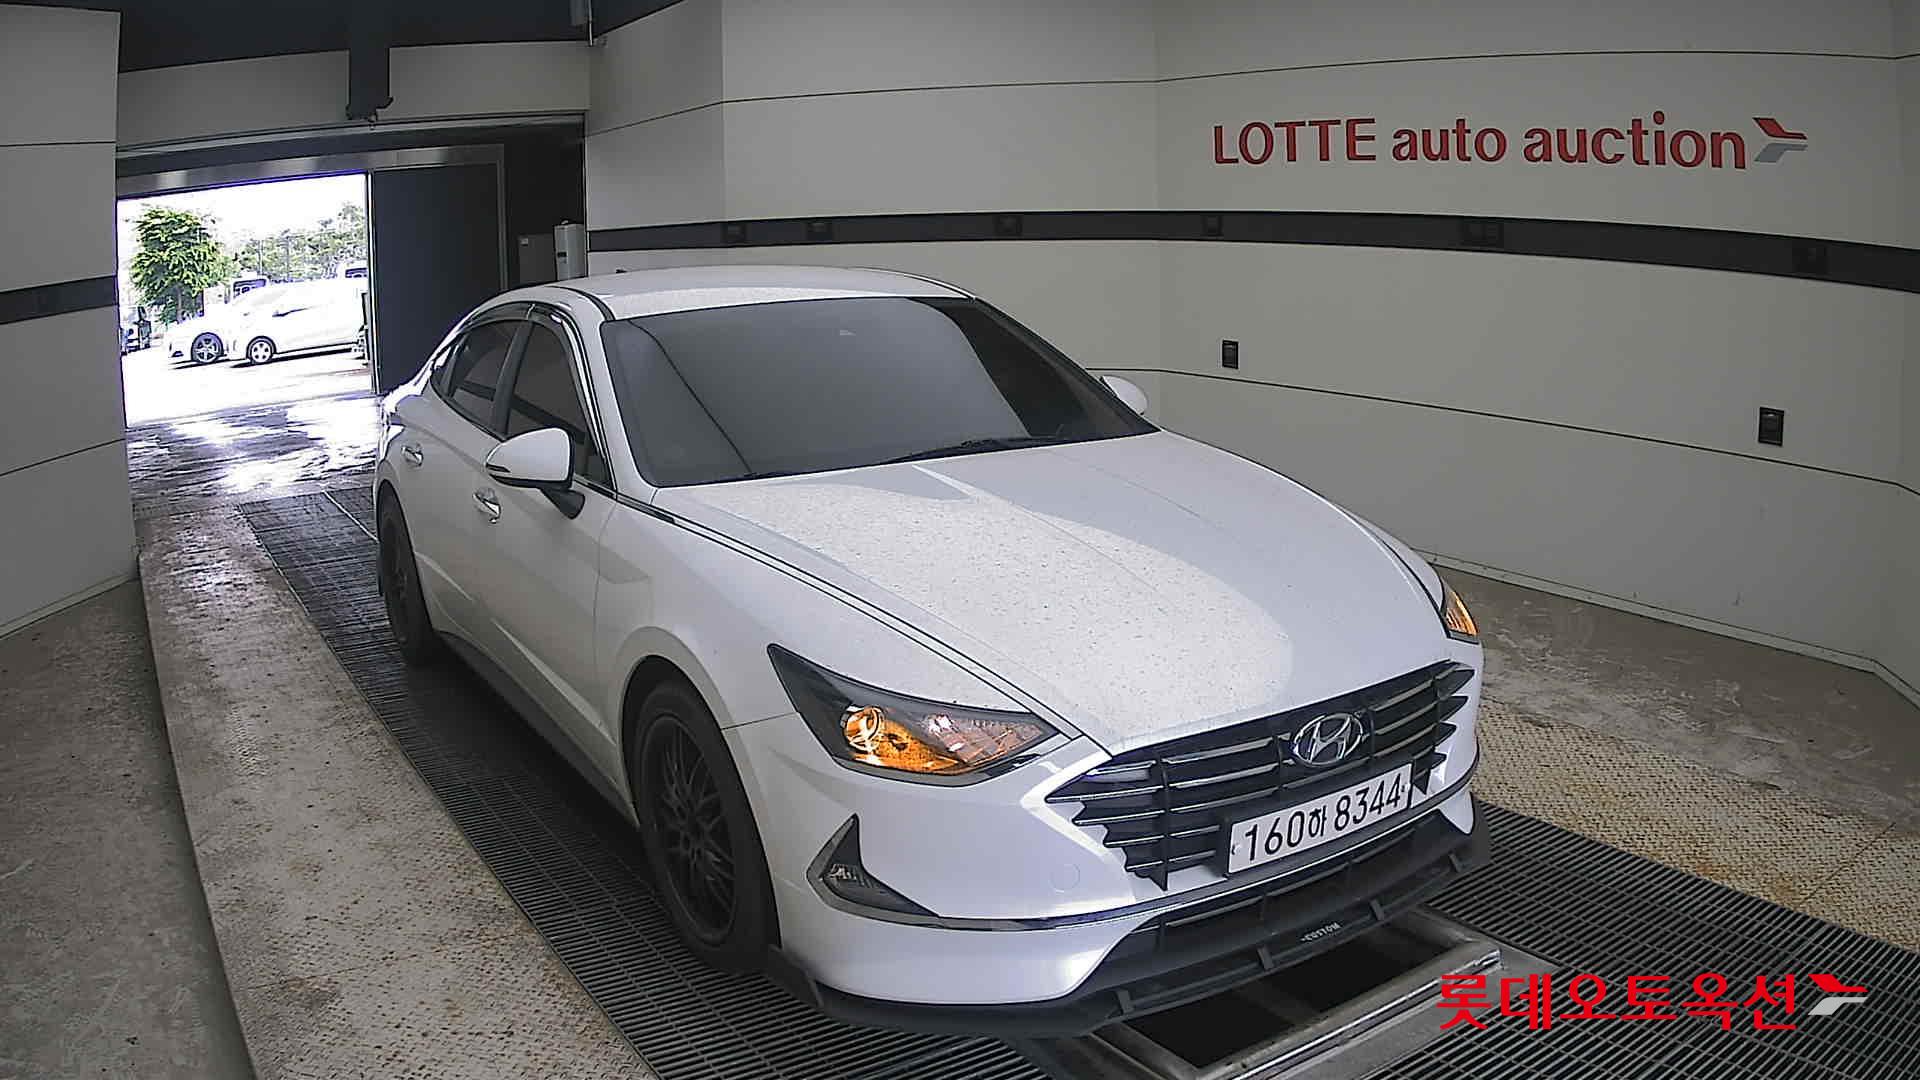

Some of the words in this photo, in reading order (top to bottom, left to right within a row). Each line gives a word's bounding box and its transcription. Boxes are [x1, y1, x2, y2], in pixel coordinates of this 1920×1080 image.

[1214, 118, 1376, 164] LOTTE
[1392, 118, 1507, 162] auto
[1523, 110, 1746, 169] auction
[1245, 805, 1327, 861] 160하
[1334, 773, 1401, 831] 8344
